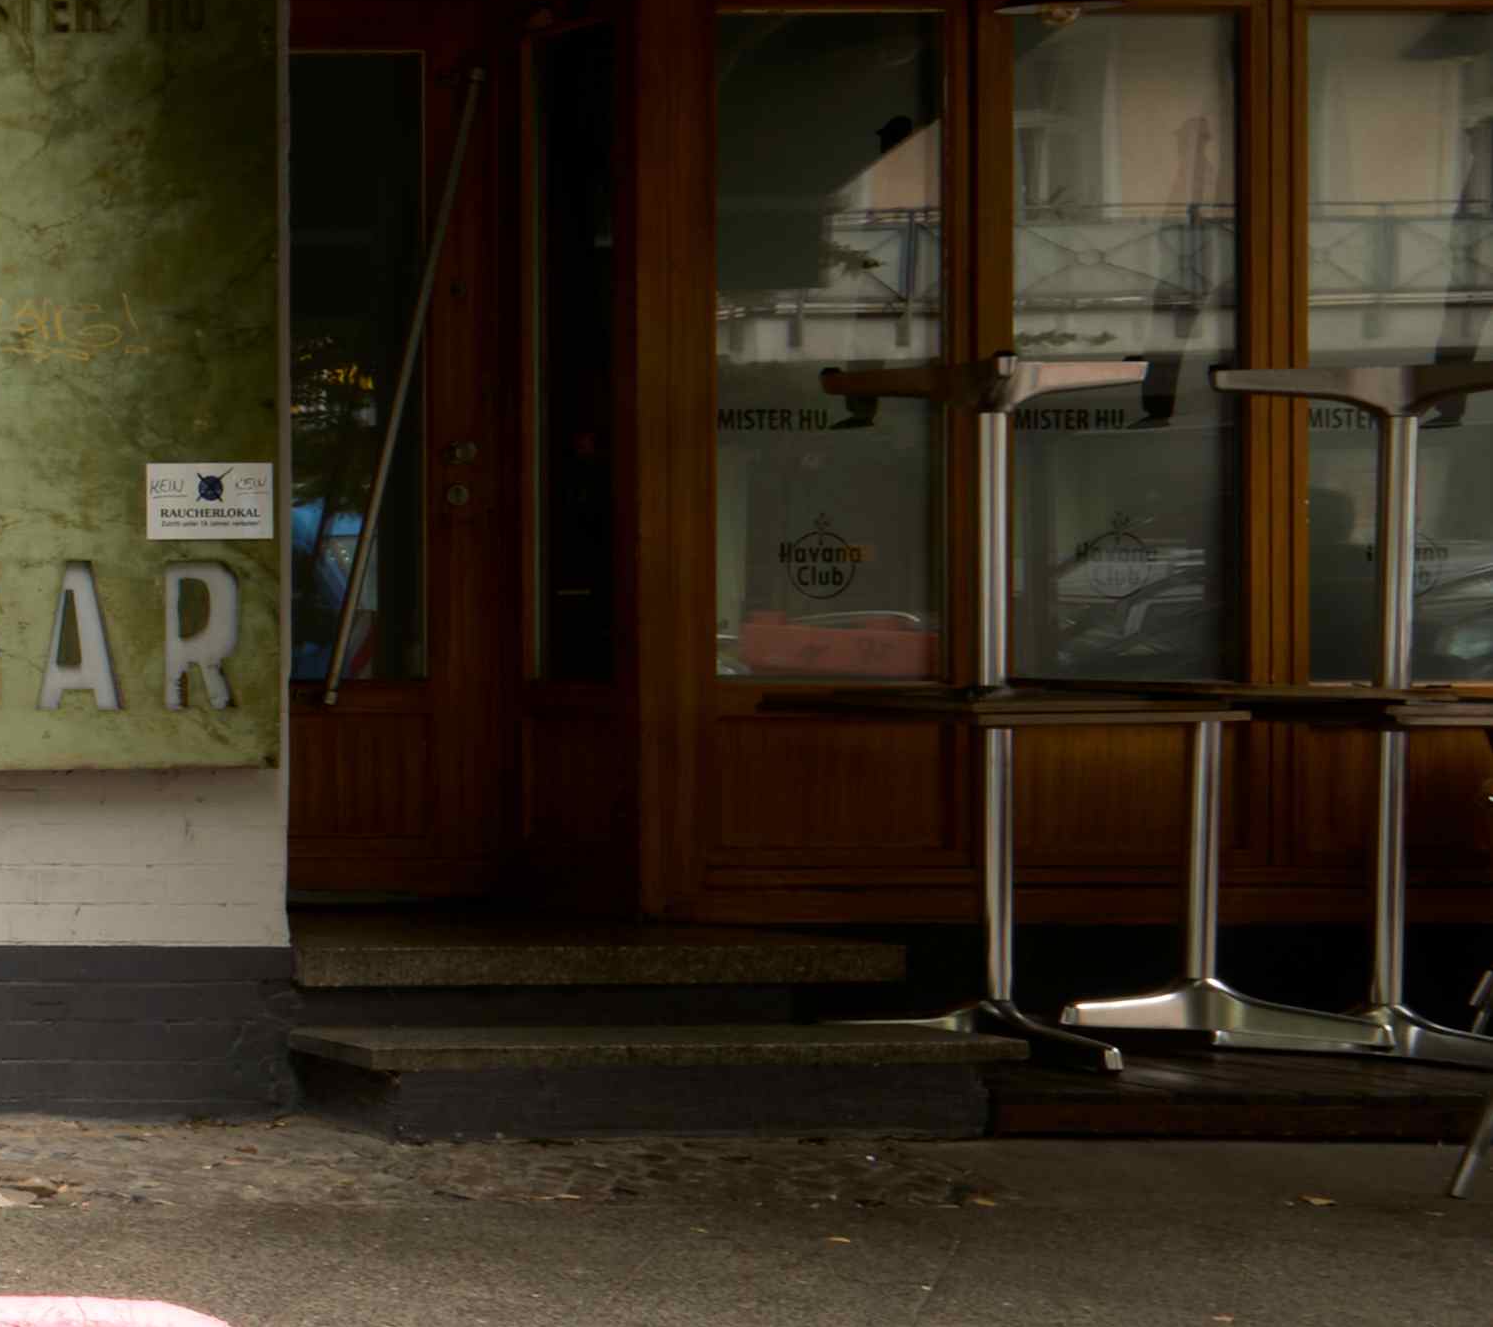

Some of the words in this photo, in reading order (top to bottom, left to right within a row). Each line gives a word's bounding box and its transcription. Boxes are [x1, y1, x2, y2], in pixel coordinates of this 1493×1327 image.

[716, 409, 792, 430] MISTER
[797, 409, 830, 430] HU
[1014, 409, 1090, 430] MISTER
[1095, 409, 1126, 430] HU
[160, 507, 261, 519] RAUCHERLOKAL
[778, 543, 862, 566] Havana
[796, 566, 845, 588] Club
